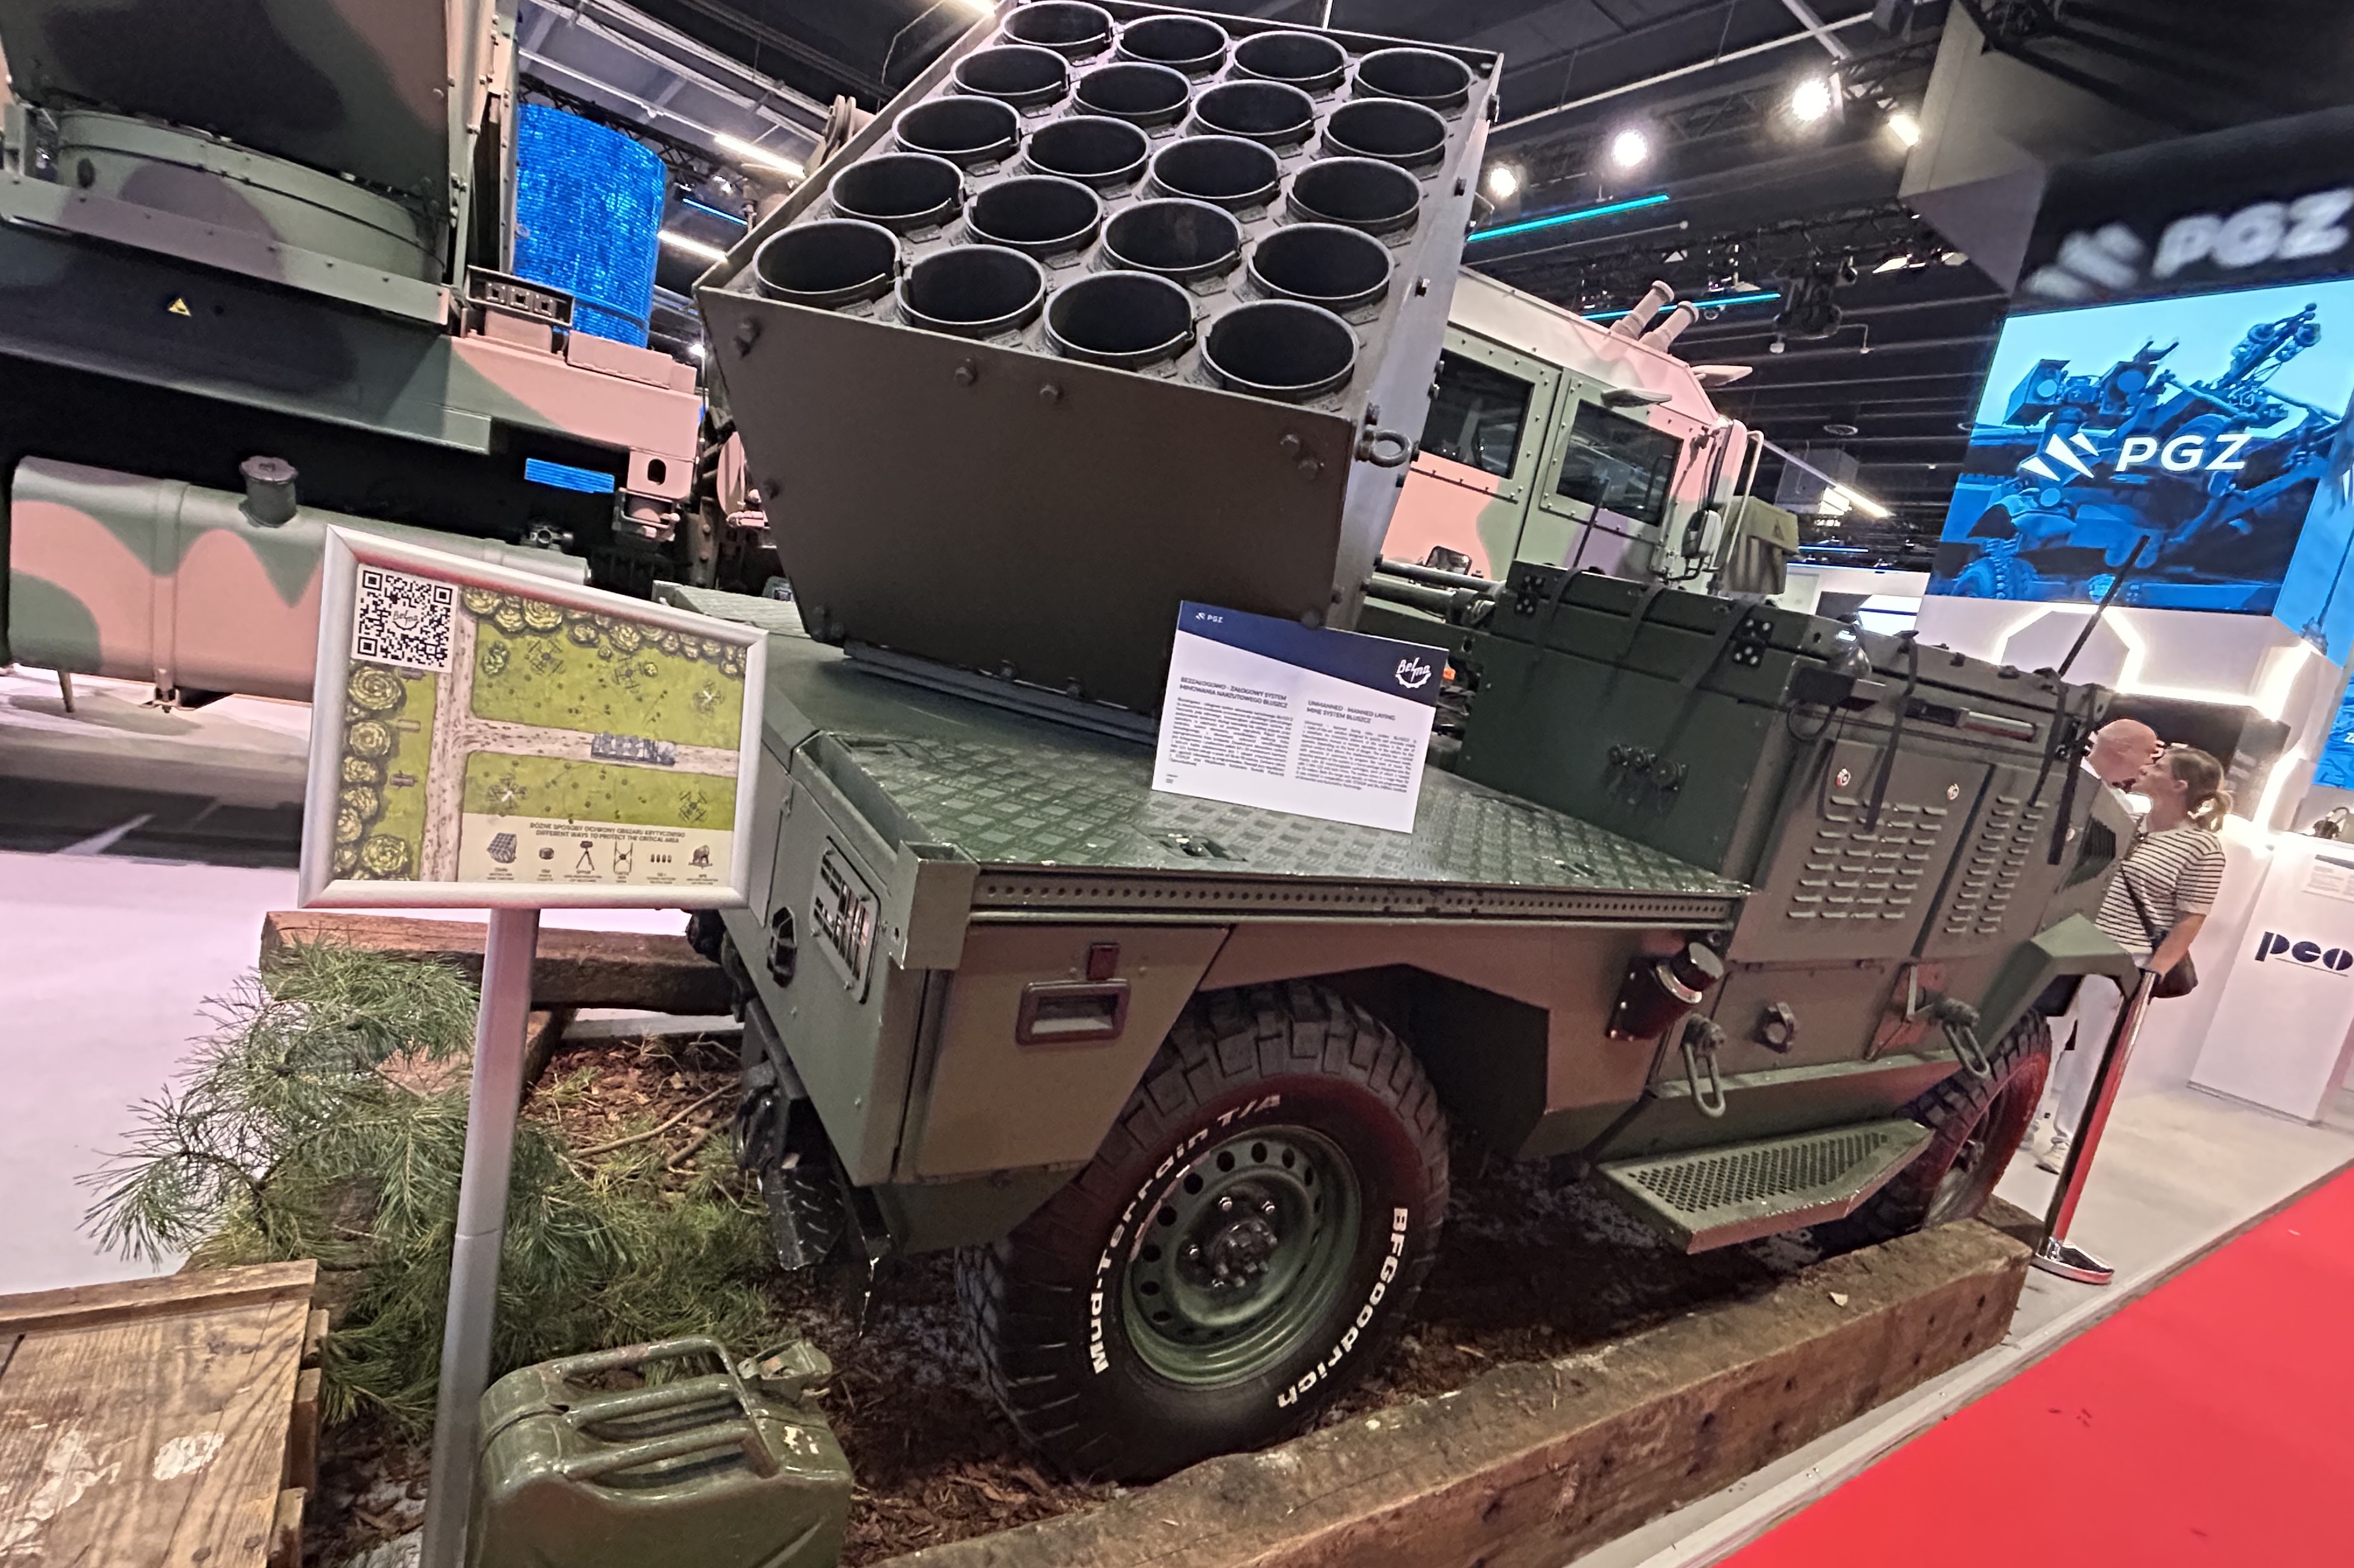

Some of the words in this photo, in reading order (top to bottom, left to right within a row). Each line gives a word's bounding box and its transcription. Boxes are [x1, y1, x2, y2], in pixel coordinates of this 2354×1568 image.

[2151, 187, 2353, 278] PGZ
[2115, 433, 2253, 472] PGZ
[1207, 614, 1224, 623] PGZ
[1265, 692, 1287, 701] SYSTEM
[1323, 710, 1345, 719] SYSTEM
[1277, 1207, 1409, 1408] BFGoodrich
